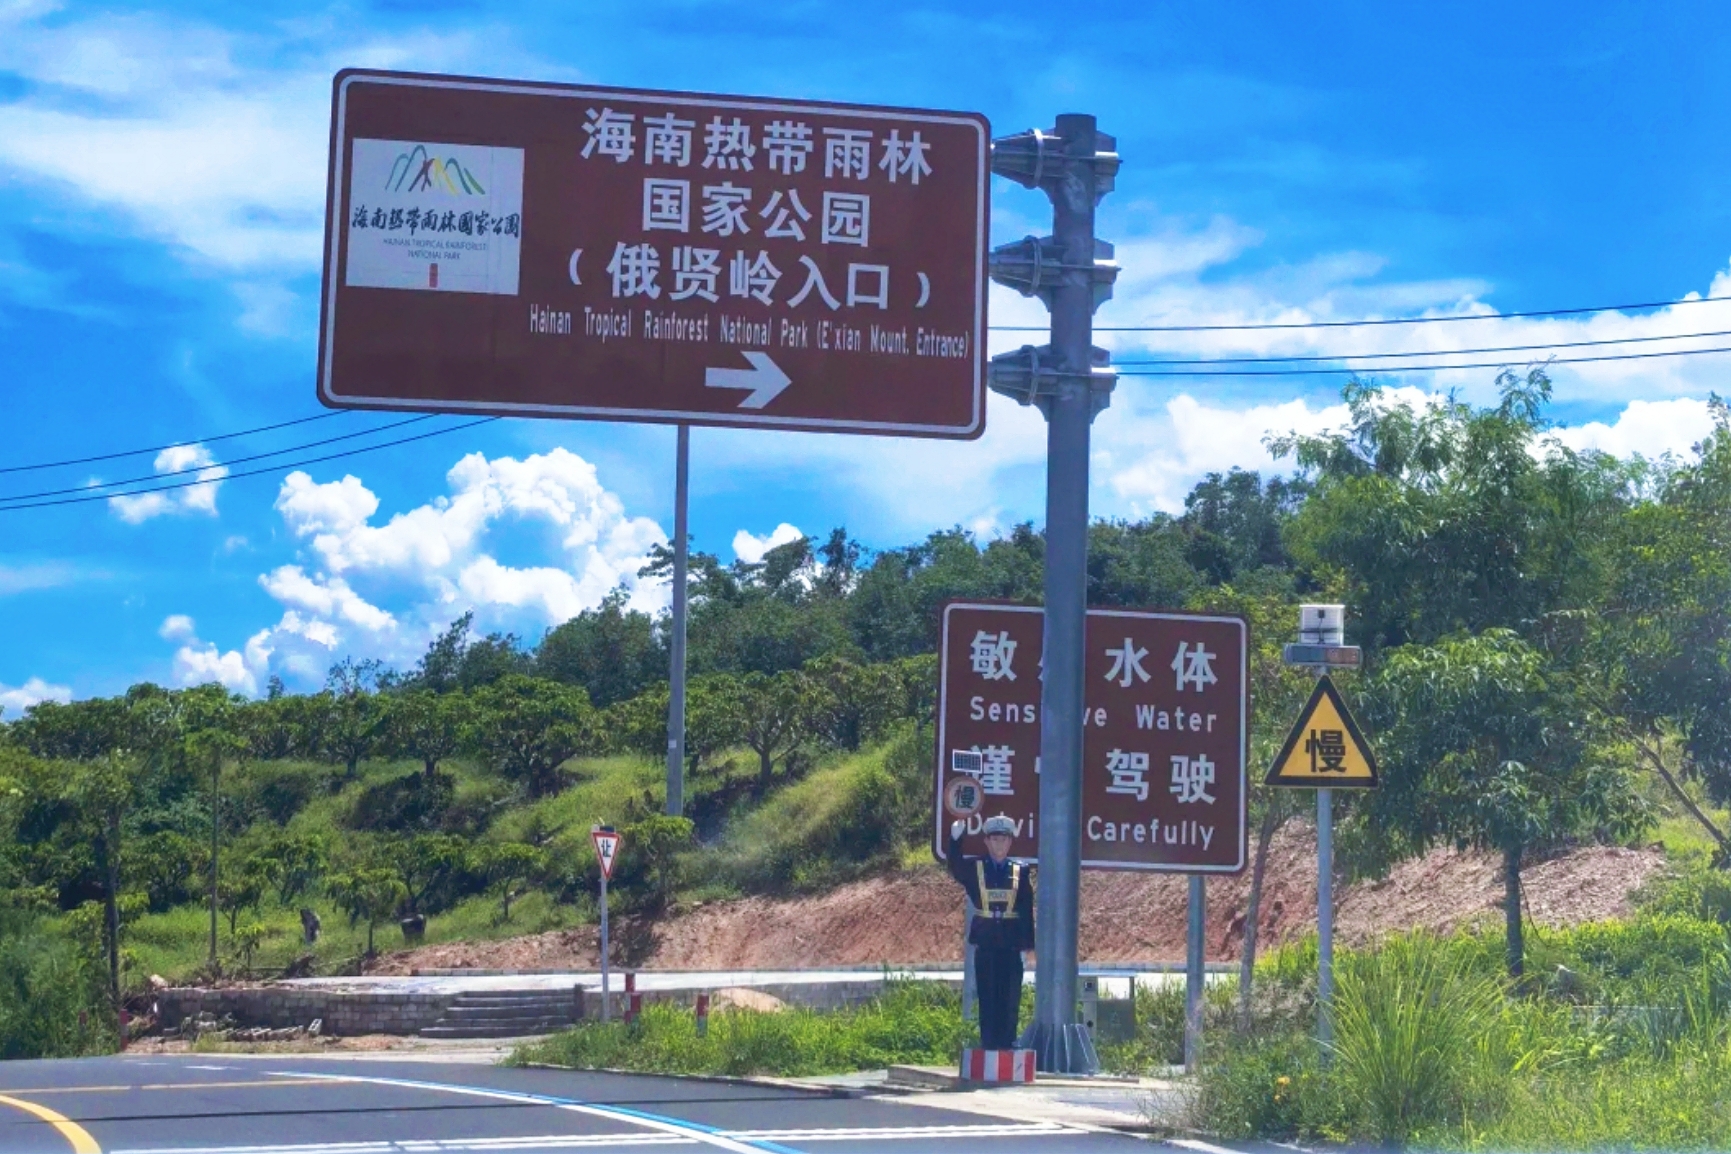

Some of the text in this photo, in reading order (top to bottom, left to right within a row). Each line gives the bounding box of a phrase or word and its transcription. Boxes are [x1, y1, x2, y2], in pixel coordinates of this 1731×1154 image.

[580, 107, 934, 185] 海南热带雨林
[641, 177, 871, 247] 国家公园
[530, 304, 571, 335] Hainan
[584, 306, 632, 344] Tropical
[644, 310, 709, 342] Rainforest
[720, 314, 772, 346] National
[780, 318, 808, 348] Park
[916, 327, 970, 359] Entrance)
[970, 630, 1219, 693] 敏水体
[970, 696, 1218, 733] Sensve Water
[966, 745, 1217, 805] 谨驾驶
[1305, 728, 1348, 773] 慢
[954, 785, 976, 809] 慢
[1087, 815, 1216, 851] Carefully
